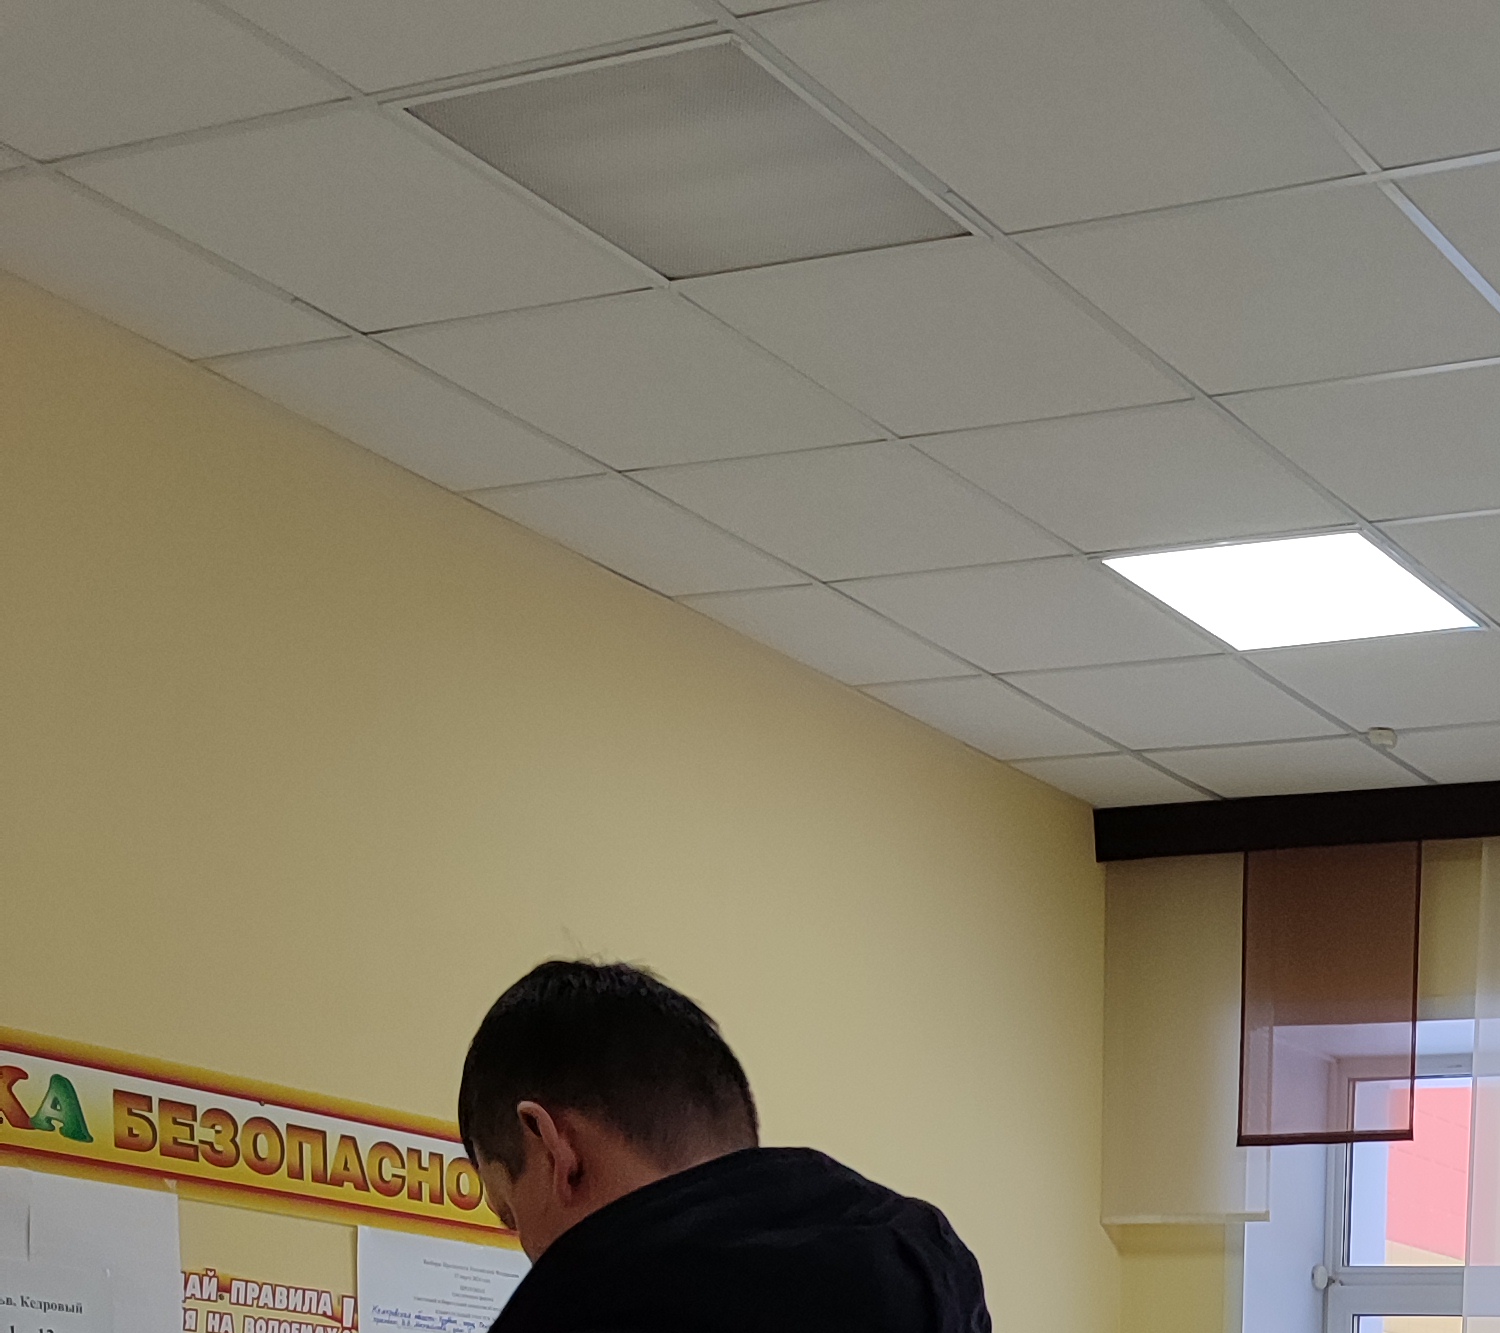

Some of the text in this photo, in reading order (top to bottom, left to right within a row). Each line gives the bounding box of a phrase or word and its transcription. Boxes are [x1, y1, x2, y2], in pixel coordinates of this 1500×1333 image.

[112, 1088, 488, 1211] БЕЗОПАСНО
[20, 1295, 83, 1314] Кедровый
[182, 1268, 219, 1302] АЙ
[229, 1278, 334, 1317] ПРАВИЛА
